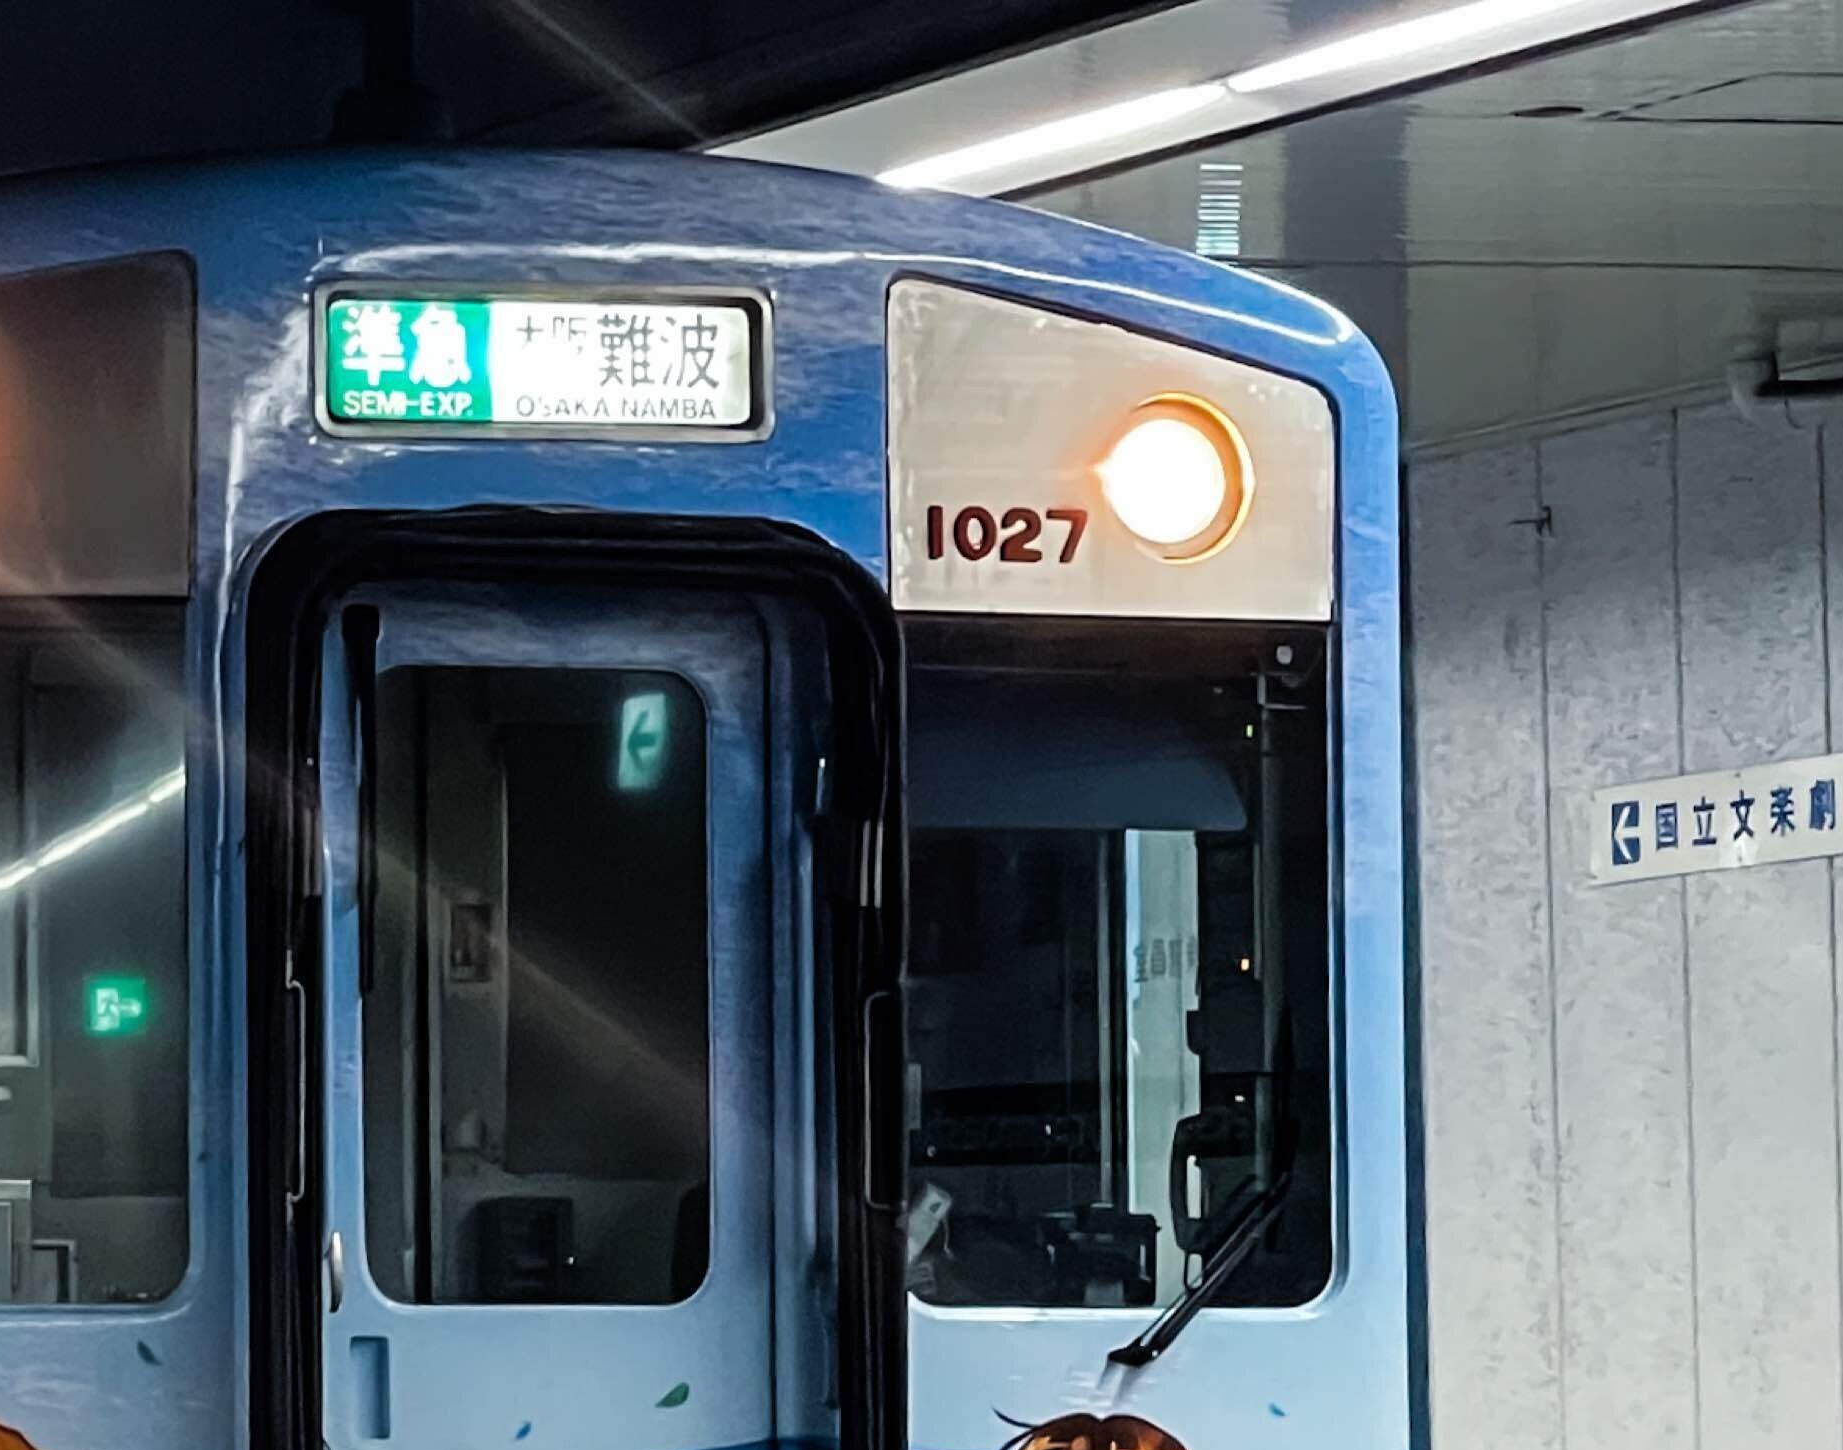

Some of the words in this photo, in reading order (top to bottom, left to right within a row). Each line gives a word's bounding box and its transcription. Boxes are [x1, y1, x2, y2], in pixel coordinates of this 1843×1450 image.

[342, 302, 472, 388] 準急
[621, 397, 717, 419] NAMBA
[926, 505, 1088, 563] 1027
